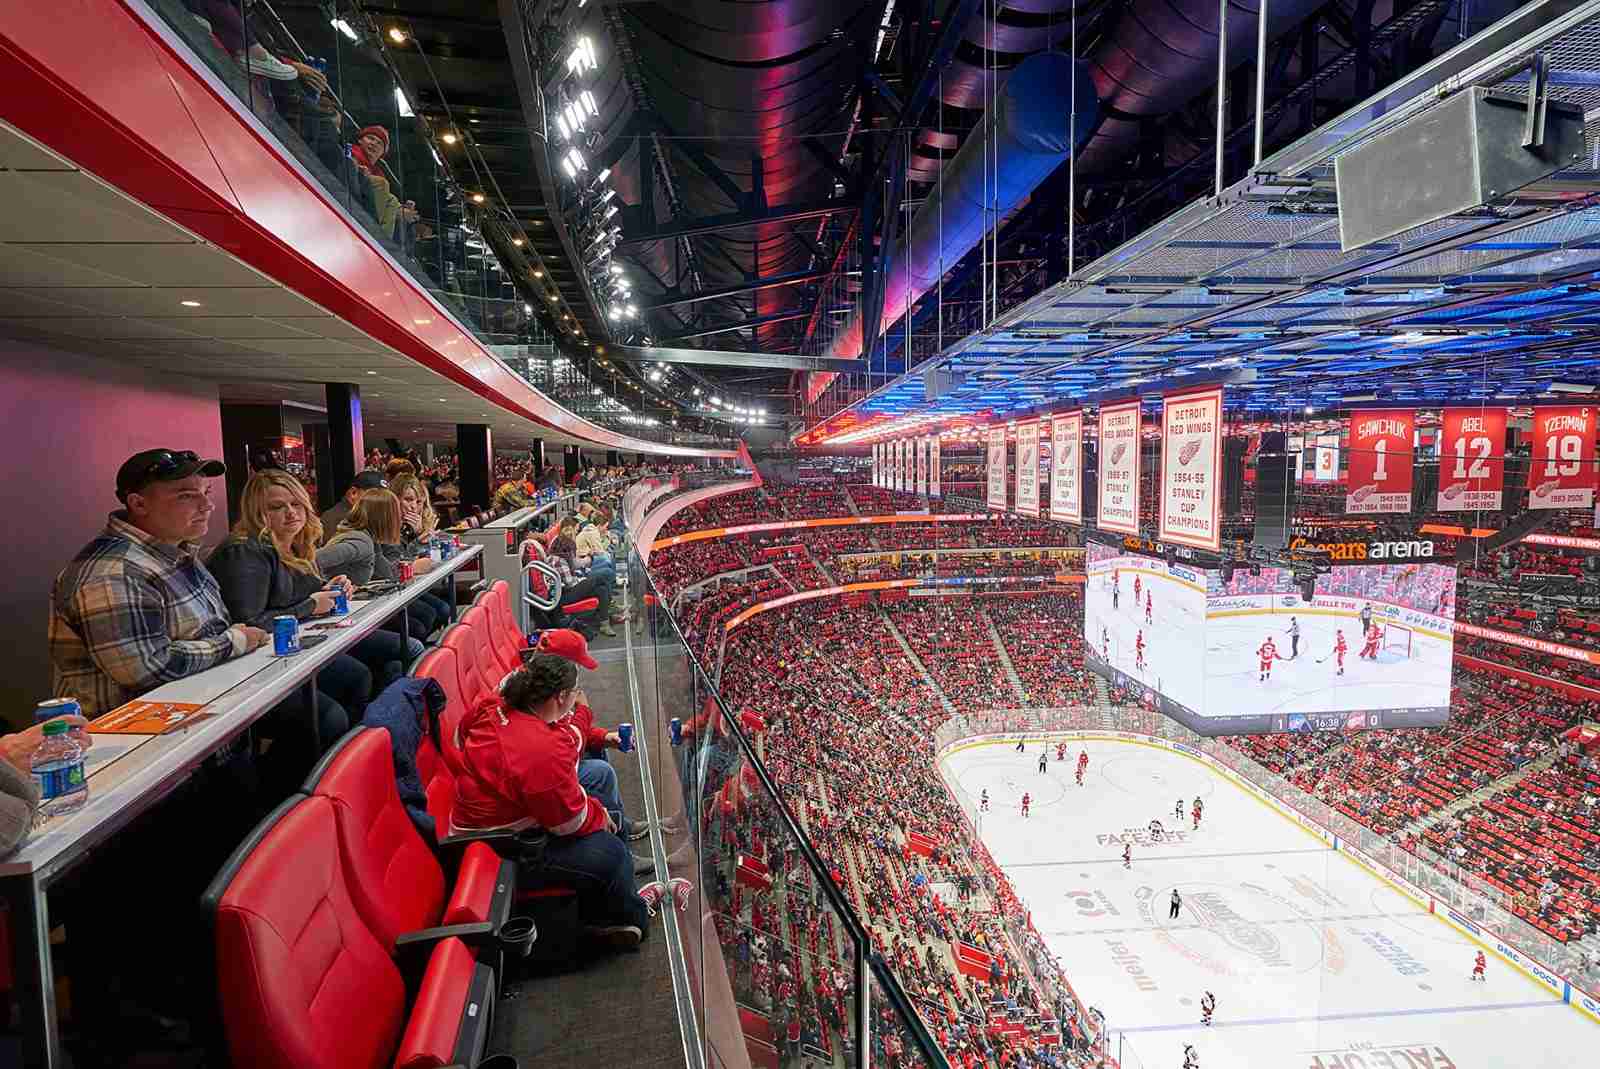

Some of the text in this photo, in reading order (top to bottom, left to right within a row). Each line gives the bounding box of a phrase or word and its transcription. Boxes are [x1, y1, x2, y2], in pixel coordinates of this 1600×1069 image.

[1176, 408, 1206, 420] DETROIT
[1582, 408, 1589, 417] C
[1169, 422, 1212, 435] RED WINGS
[1357, 418, 1407, 440] SAWCHUK
[1461, 417, 1487, 433] ABEL
[1544, 415, 1586, 433] YZERMAN
[1373, 439, 1387, 480] 1
[1453, 437, 1492, 478] 12
[1544, 435, 1582, 476] 19
[1174, 473, 1205, 484] 1954-55
[1106, 483, 1129, 493] STANLEY
[1172, 488, 1206, 500] STANLEY
[1103, 507, 1132, 519] CHAMPIONS
[1180, 503, 1196, 514] CUP
[1167, 515, 1210, 530] CHAMPIONS
[1370, 540, 1434, 559] arena
[1315, 718, 1340, 729] 16:38
[1370, 716, 1378, 726] 0
[1096, 830, 1187, 847] FACE-FF
